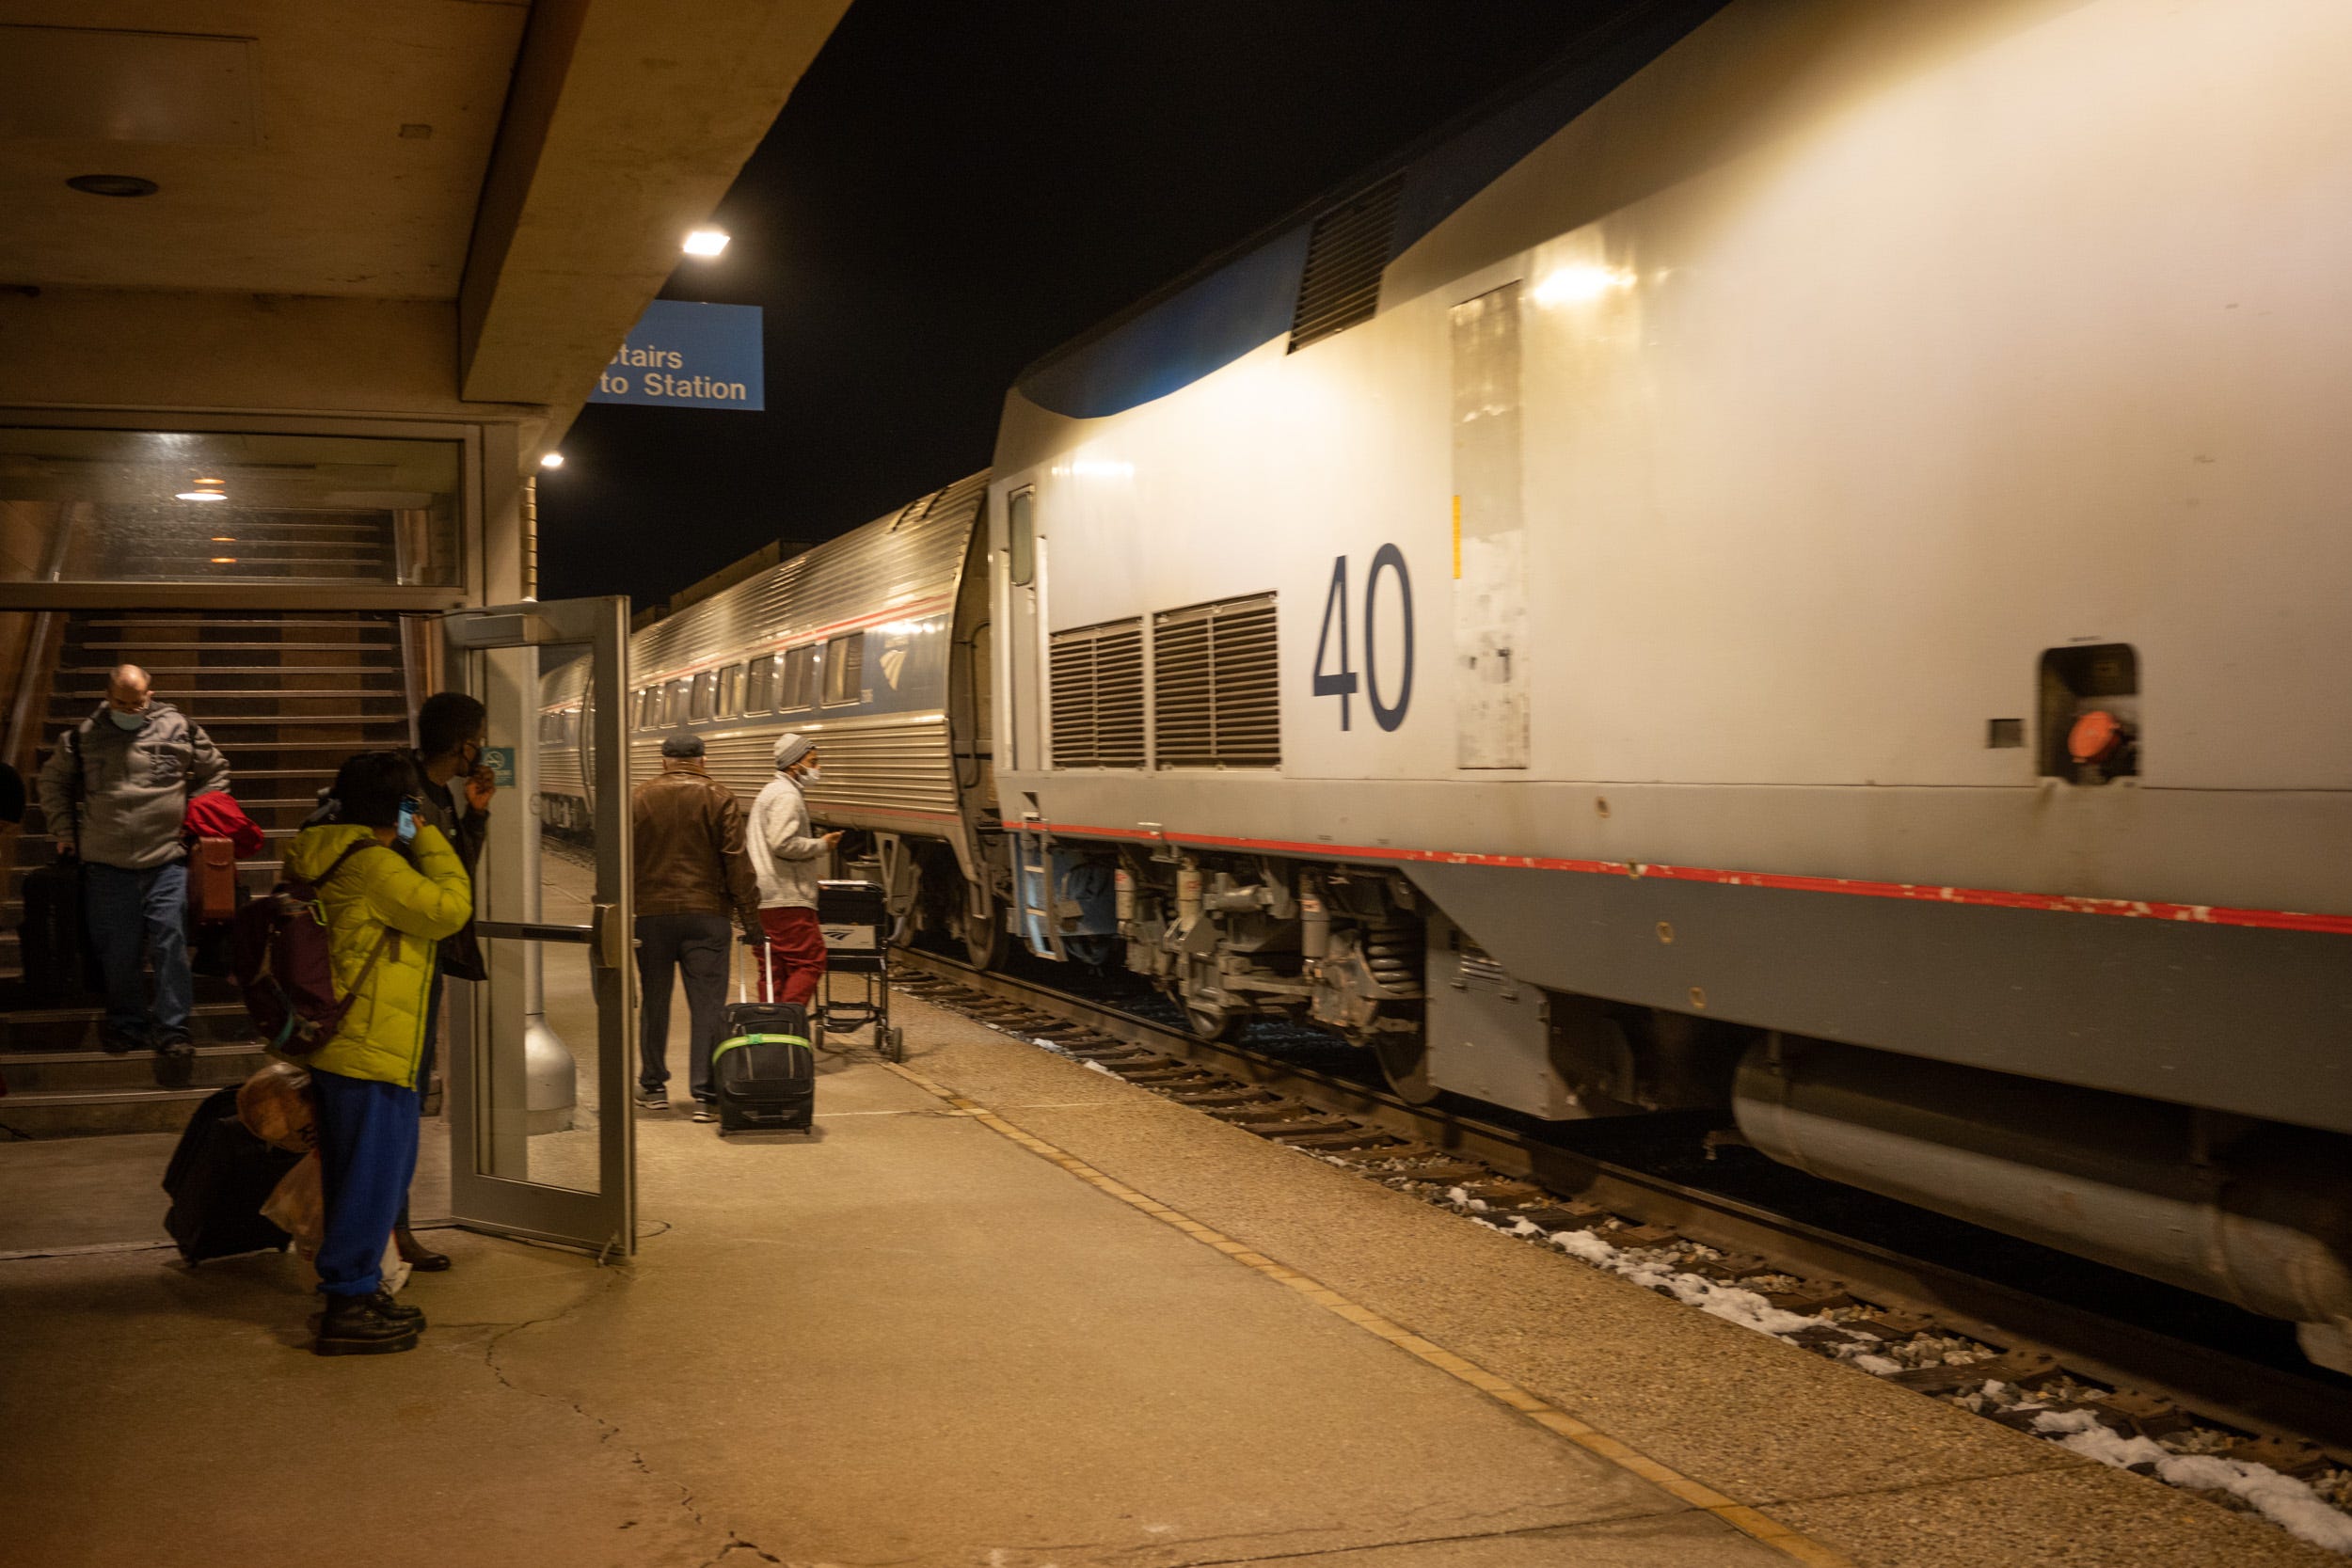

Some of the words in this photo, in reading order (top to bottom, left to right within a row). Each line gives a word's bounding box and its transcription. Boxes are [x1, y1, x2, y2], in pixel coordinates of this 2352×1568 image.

[610, 343, 684, 370] tairs
[599, 372, 629, 395] to
[644, 372, 747, 401] Station
[1312, 542, 1415, 733] 40
